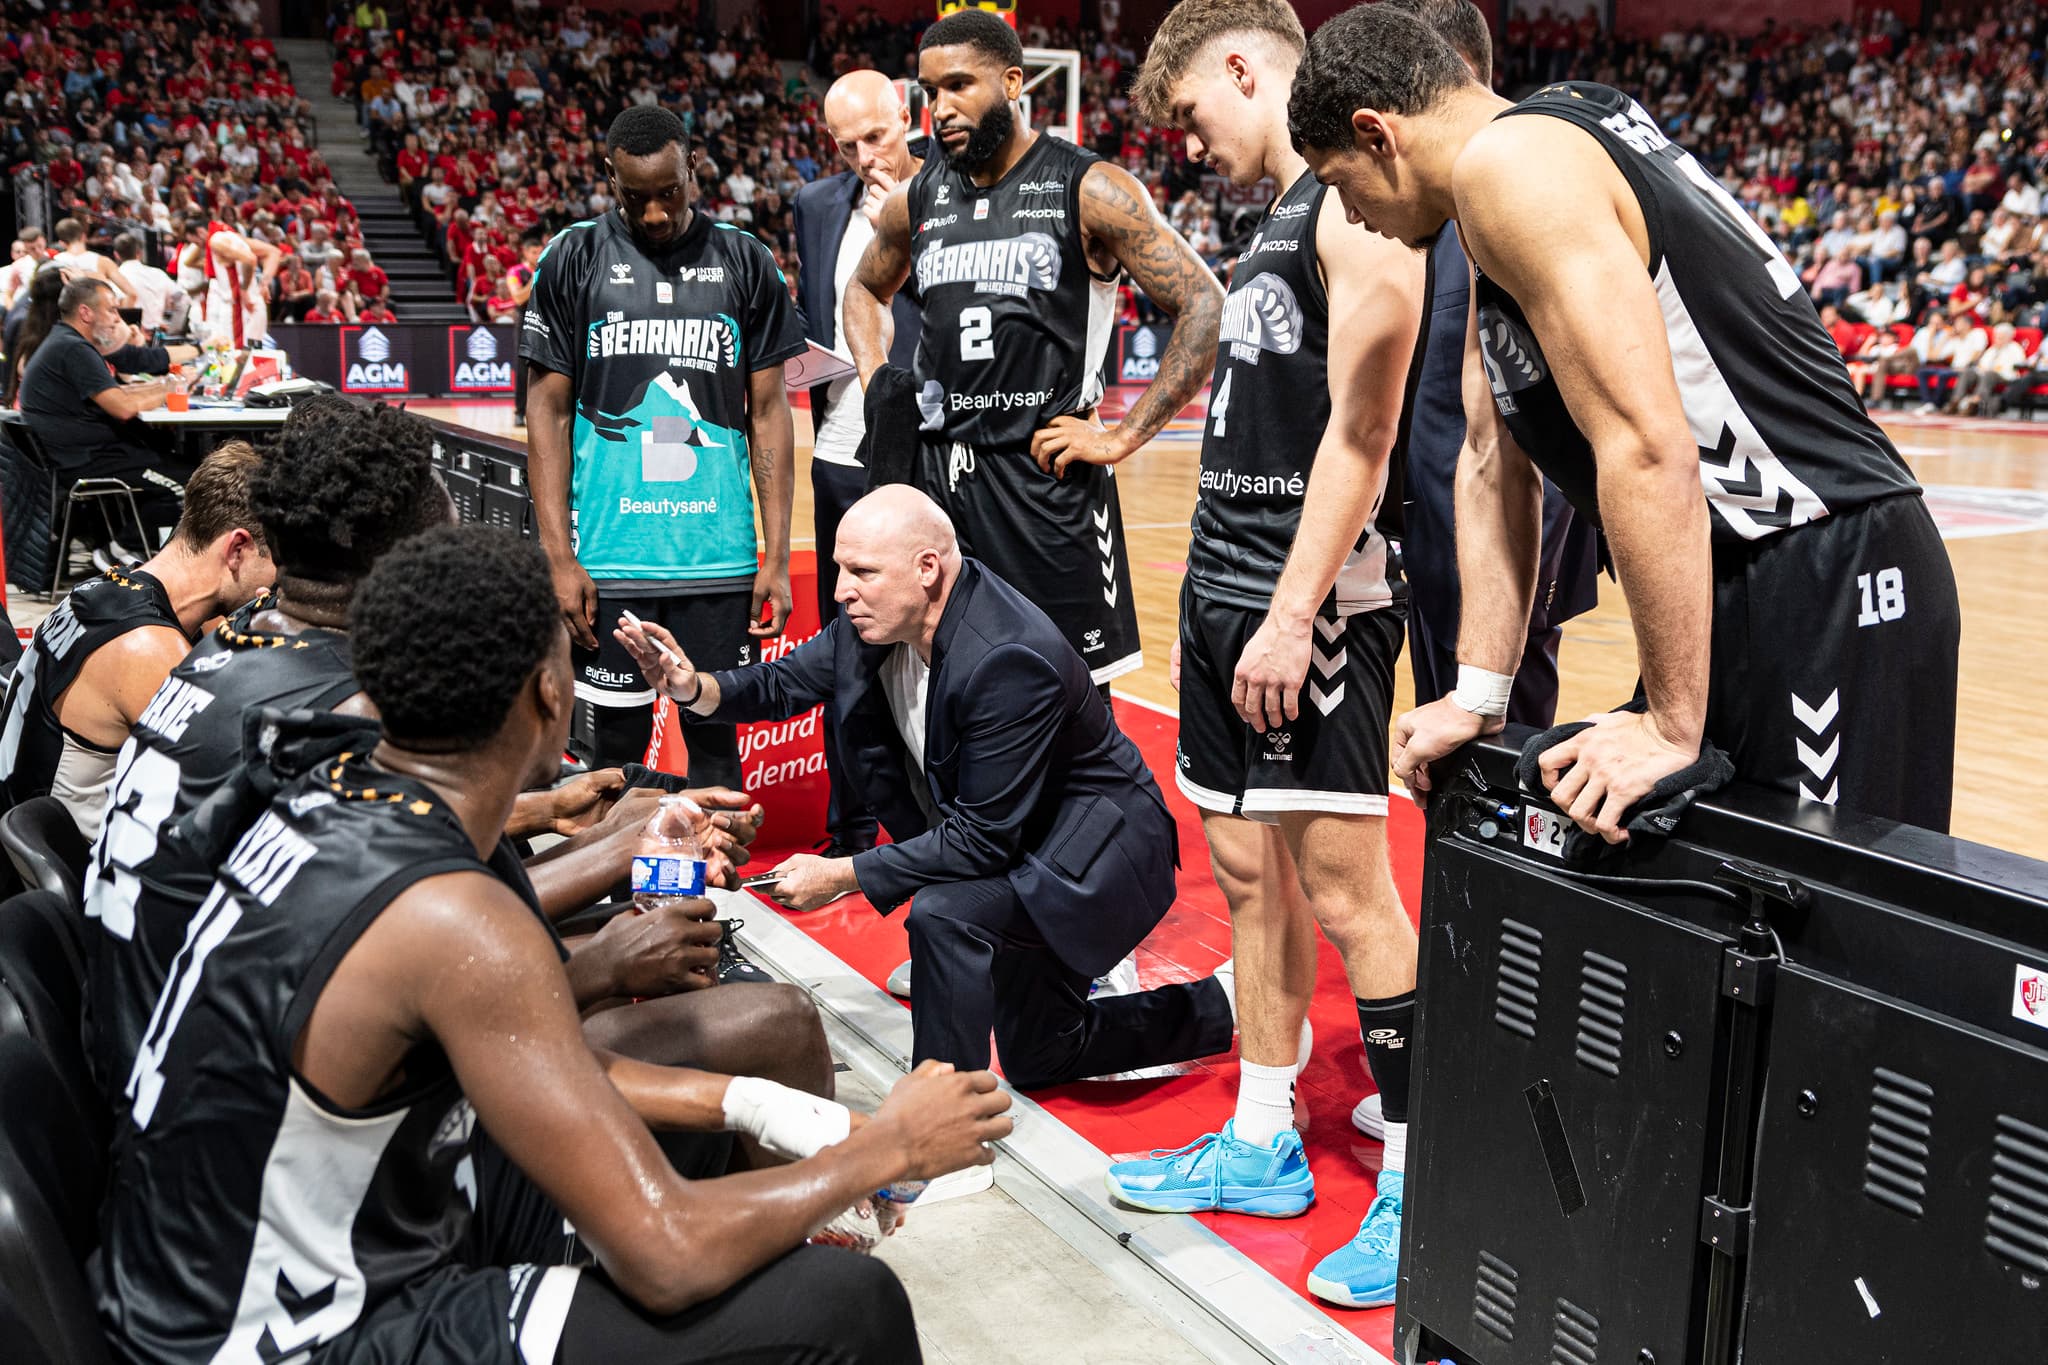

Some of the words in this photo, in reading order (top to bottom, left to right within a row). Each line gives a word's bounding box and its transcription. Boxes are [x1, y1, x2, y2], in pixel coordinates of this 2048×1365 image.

[696, 266, 724, 276] INTER
[696, 274, 724, 283] SPORT
[959, 305, 995, 362] 2
[346, 361, 405, 383] AGM
[454, 361, 513, 383] AGM
[1210, 367, 1233, 438] 4
[619, 496, 718, 518] Beautysané
[1857, 566, 1906, 628] 18
[1262, 751, 1294, 762] hummel
